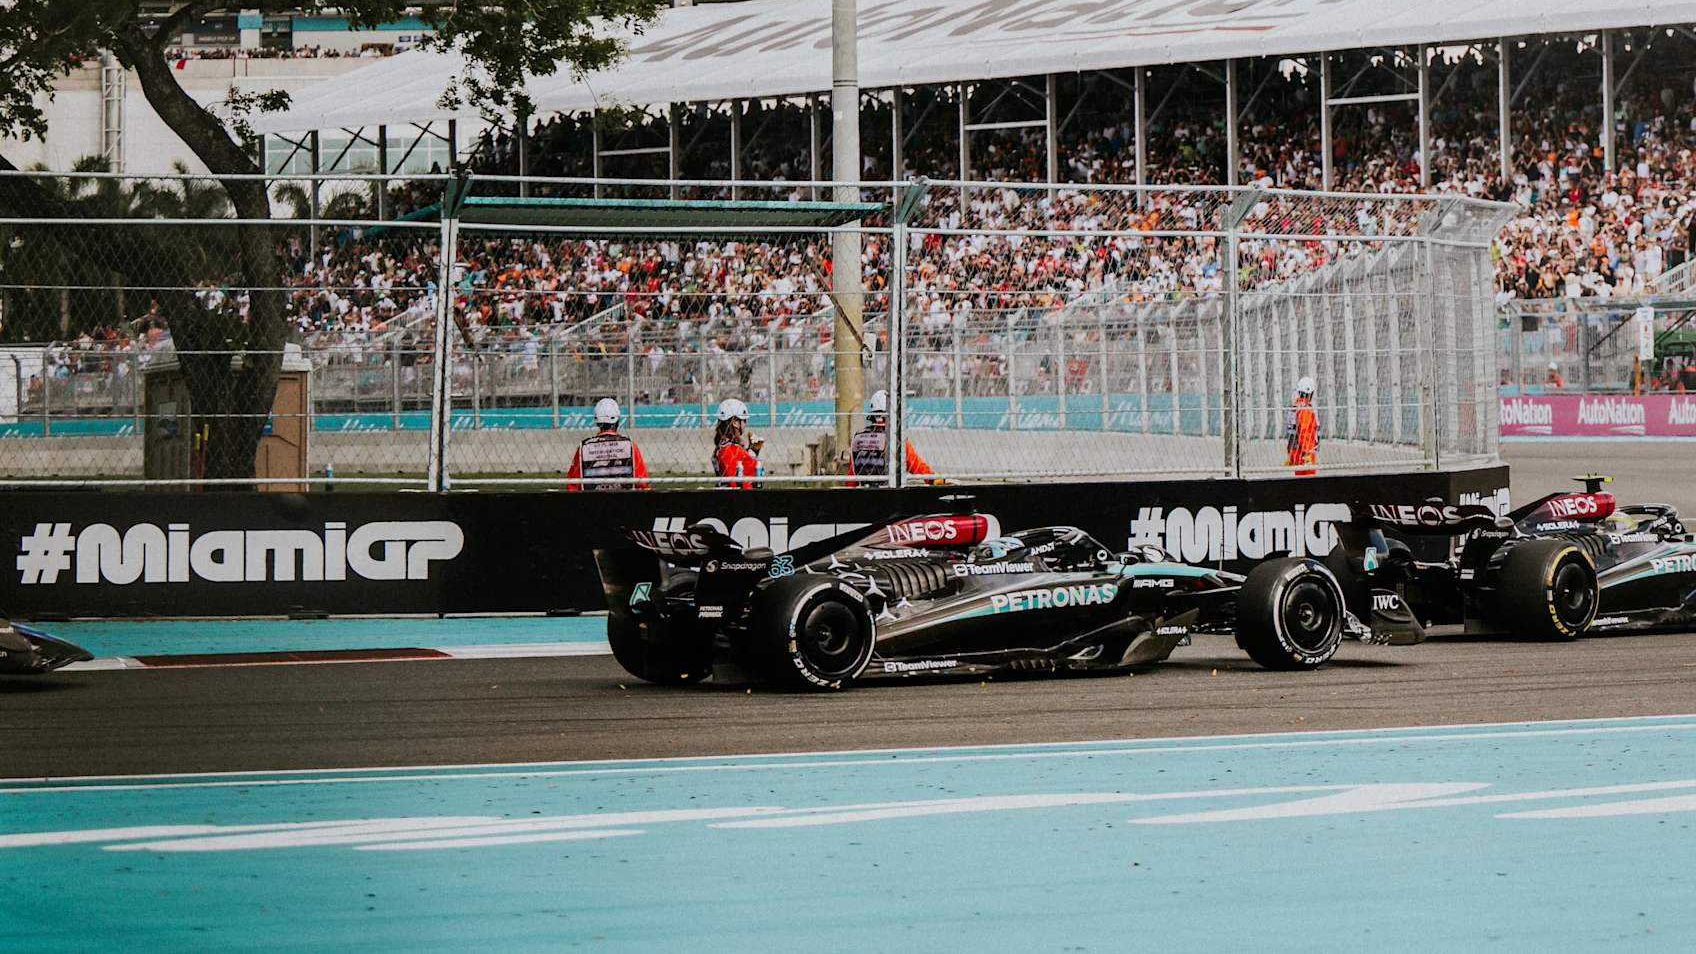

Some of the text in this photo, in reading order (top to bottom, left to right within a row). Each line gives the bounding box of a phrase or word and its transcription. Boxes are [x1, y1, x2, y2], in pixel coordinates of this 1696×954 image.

[1500, 398, 1552, 425] toNation
[1577, 397, 1646, 425] AutoNation
[1547, 495, 1598, 517] INEOS
[1369, 504, 1461, 526] INEOS
[886, 520, 957, 543] INEOS
[1542, 520, 1575, 531] SOLERA
[1480, 529, 1509, 539] Snapdragon
[1619, 532, 1659, 543] TeamViewer
[632, 530, 710, 556] INEOS
[1030, 544, 1048, 556] AMD
[15, 520, 465, 585] #MiamiGP
[874, 548, 920, 560] SOLERA
[720, 561, 767, 571] Snapdragon
[768, 554, 795, 578] 63
[967, 561, 1034, 575] TeamViewer
[1141, 578, 1174, 587] AMG
[990, 583, 1116, 614] PETRONAS
[1372, 594, 1400, 610] IWC
[1161, 626, 1183, 636] SOLERA
[793, 657, 830, 687] ZERO
[896, 659, 958, 672] TeamViewer
